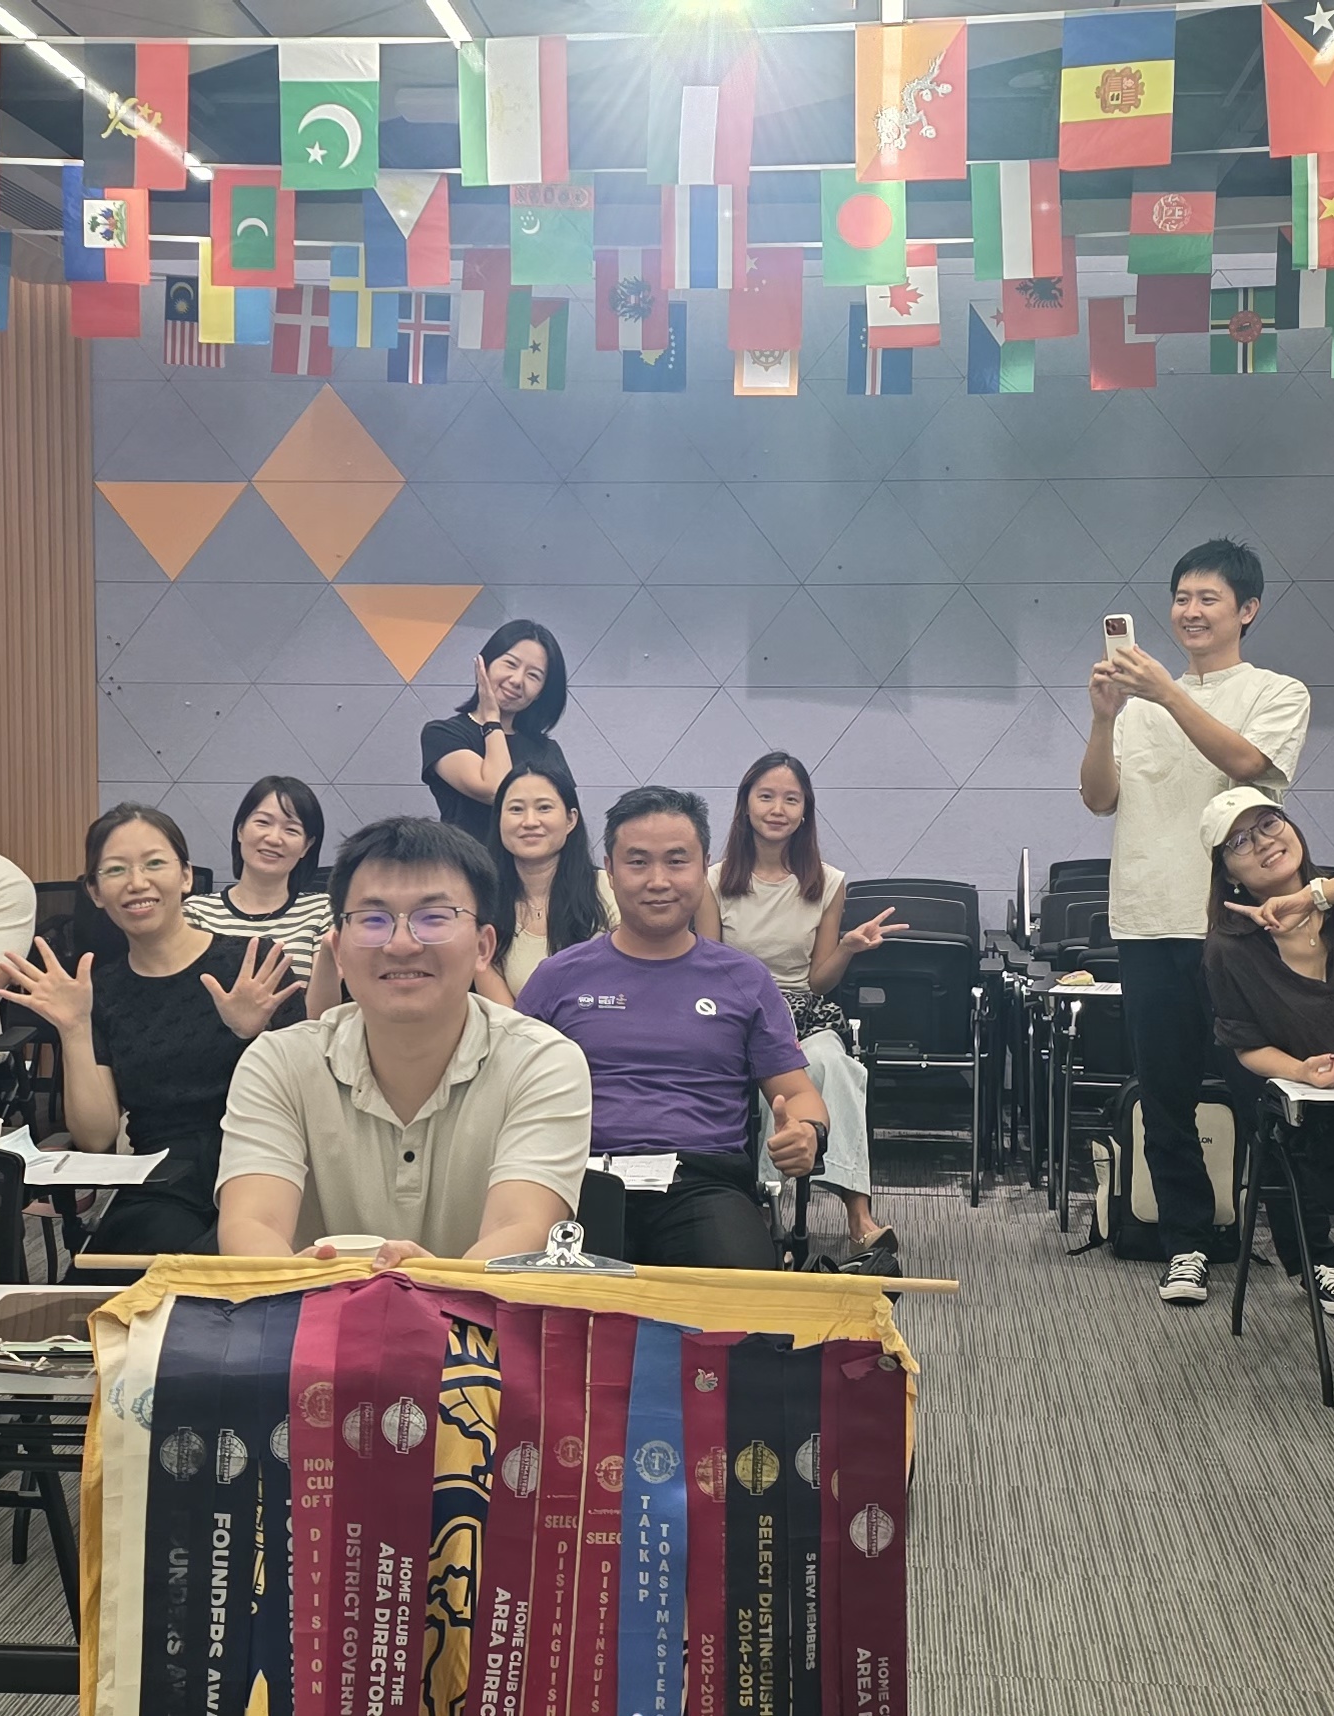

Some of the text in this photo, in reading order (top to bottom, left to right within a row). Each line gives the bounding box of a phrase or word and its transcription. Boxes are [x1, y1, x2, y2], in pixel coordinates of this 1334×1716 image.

[301, 1495, 320, 1508] OF
[638, 1495, 651, 1602] TALK UP
[805, 1564, 817, 1598] NEW
[310, 1528, 323, 1694] DIVISION
[340, 1523, 362, 1715] DISTRICT GOVERN
[367, 1542, 395, 1716] AREA DIRECTOR
[390, 1556, 414, 1706] HOME CLUB OF THE
[489, 1586, 512, 1648] AREA
[511, 1600, 528, 1648] HOME
[546, 1541, 568, 1716] DISTINGUISH
[655, 1523, 671, 1716] TOASTMASTER
[758, 1515, 774, 1716] SELECT DISTINGUISH
[805, 1601, 817, 1671] MEMBERS
[506, 1650, 522, 1692] CLUB
[701, 1633, 715, 1716] 2012-201
[738, 1608, 754, 1707] 2014-2015
[856, 1647, 872, 1707] AREA
[877, 1656, 889, 1702] HOME
